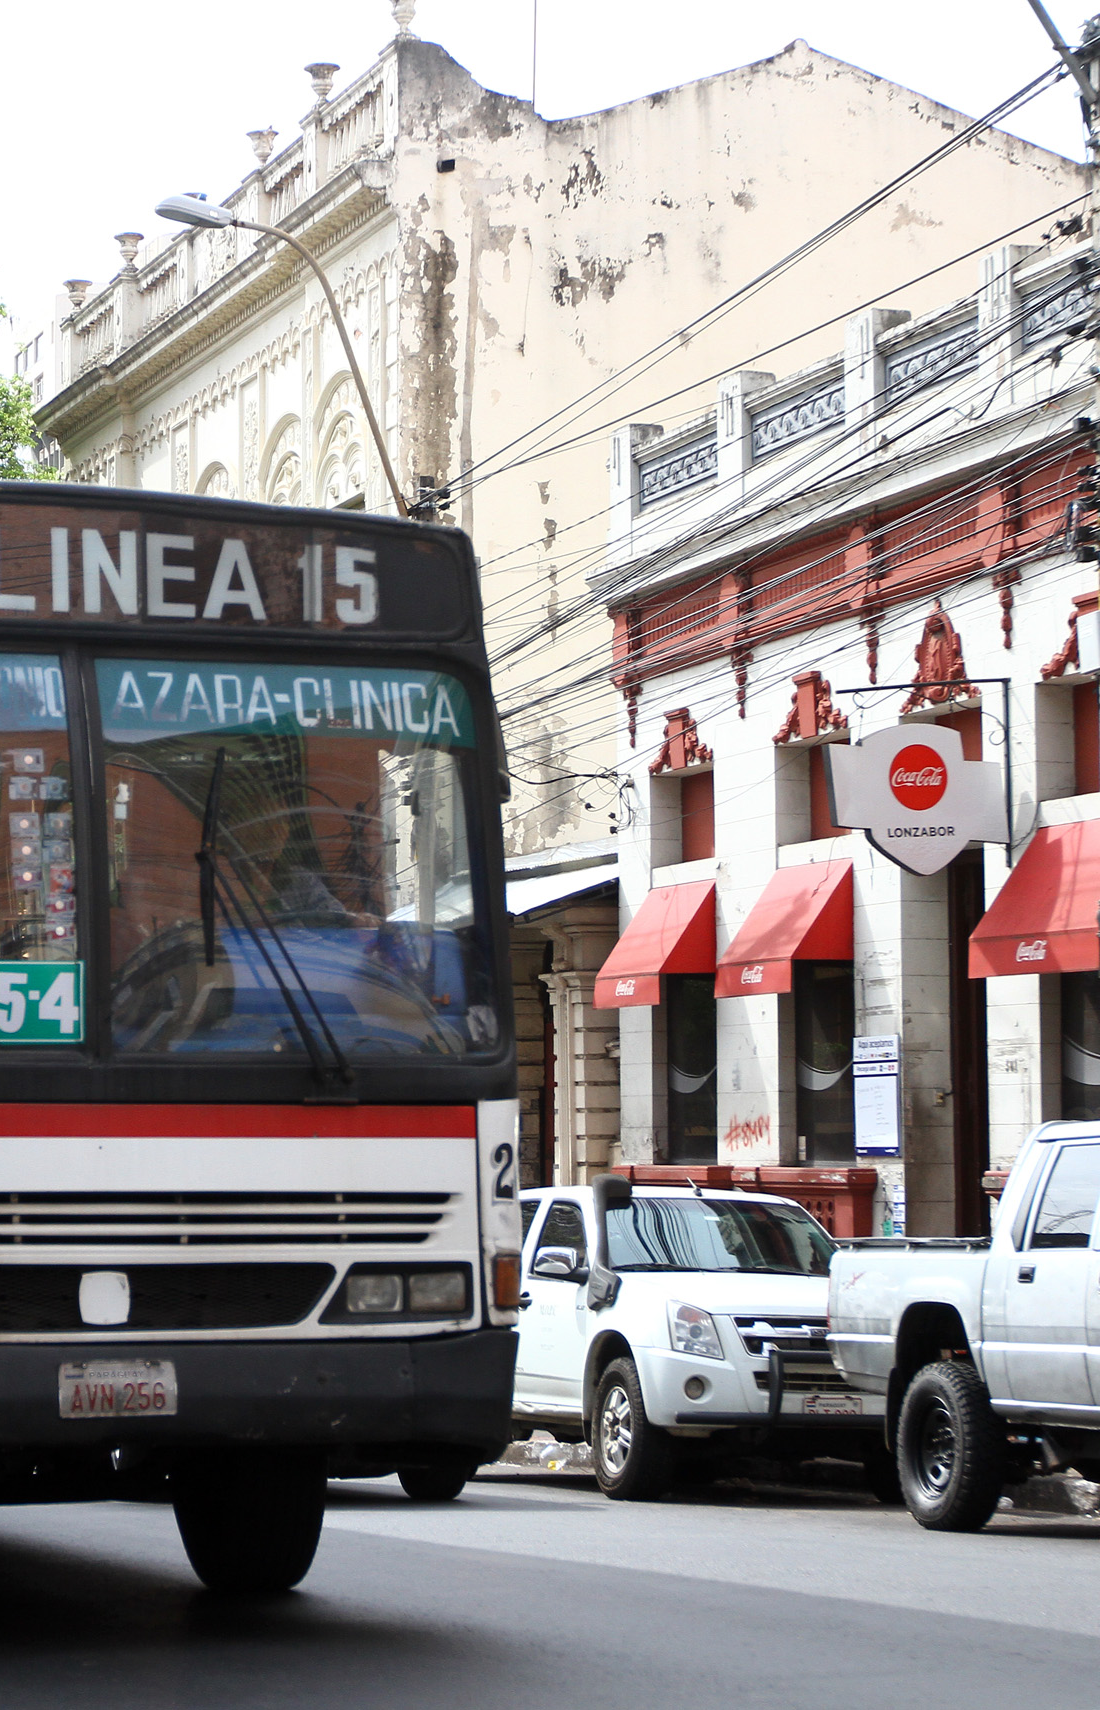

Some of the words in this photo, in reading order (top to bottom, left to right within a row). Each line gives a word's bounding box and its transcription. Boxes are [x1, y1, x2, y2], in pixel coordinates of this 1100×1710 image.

[297, 544, 379, 625] 15
[887, 826, 955, 839] LONZABOR
[70, 1383, 114, 1413] AVN
[122, 1381, 167, 1410] 256
